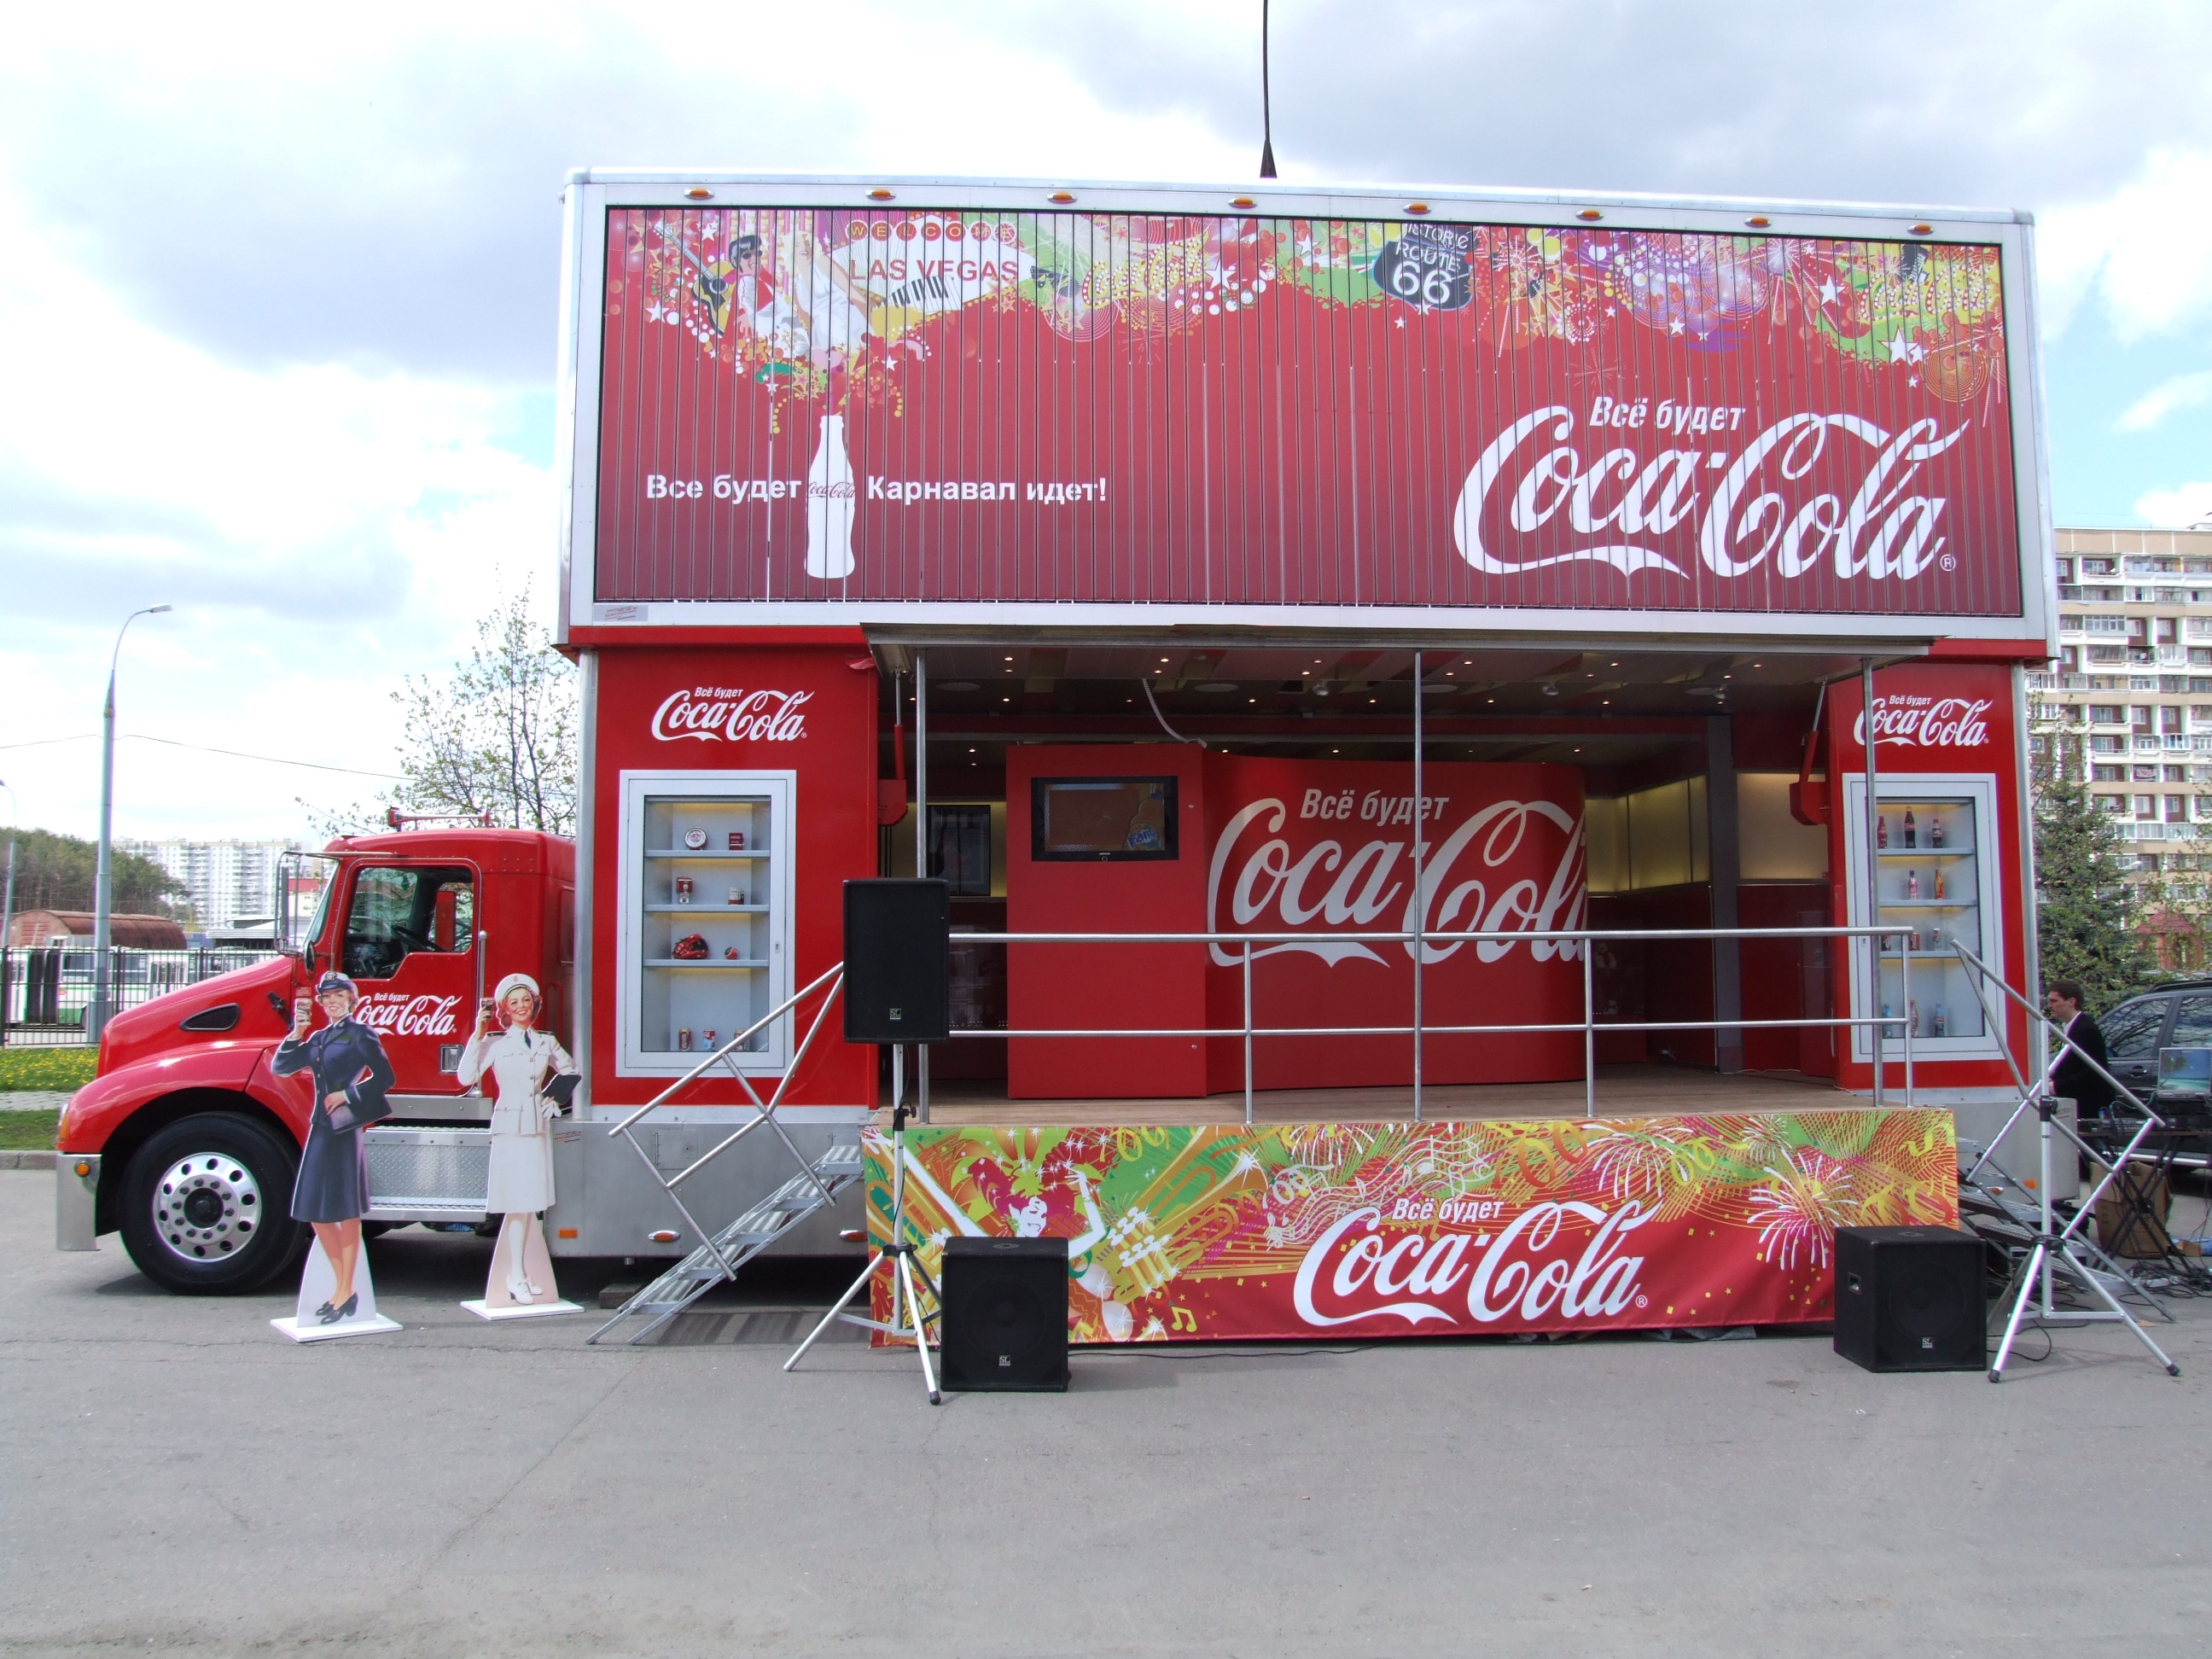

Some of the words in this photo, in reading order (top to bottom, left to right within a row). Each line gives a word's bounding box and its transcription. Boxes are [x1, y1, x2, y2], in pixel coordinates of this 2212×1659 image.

[850, 259, 906, 281] LAS
[916, 259, 1018, 282] VEGAS
[1395, 242, 1460, 272] ROUTE
[1393, 260, 1450, 305] 66
[1589, 396, 1649, 428] Всё
[1656, 398, 1746, 436] будет
[647, 474, 703, 499] Все
[713, 474, 802, 505] будет
[808, 481, 856, 499] Coca-Cola
[868, 475, 1016, 506] Карнавал
[1027, 477, 1107, 505] идет!
[1453, 405, 1970, 581] Coca-Cola
[694, 686, 714, 697] Всё
[714, 687, 744, 700] будет
[1889, 695, 1906, 705] Всё
[1906, 695, 1932, 707] будет
[652, 690, 815, 742] Coca-Cola
[1854, 698, 1994, 747] Coca-Cola
[1300, 789, 1355, 820] Всё
[1360, 789, 1450, 826] будет
[374, 992, 389, 1001] Всё
[388, 992, 410, 1003] будет
[1392, 1197, 1434, 1221] Всё
[1438, 1196, 1505, 1225] будет
[1293, 1199, 1666, 1326] Coca-Cola
